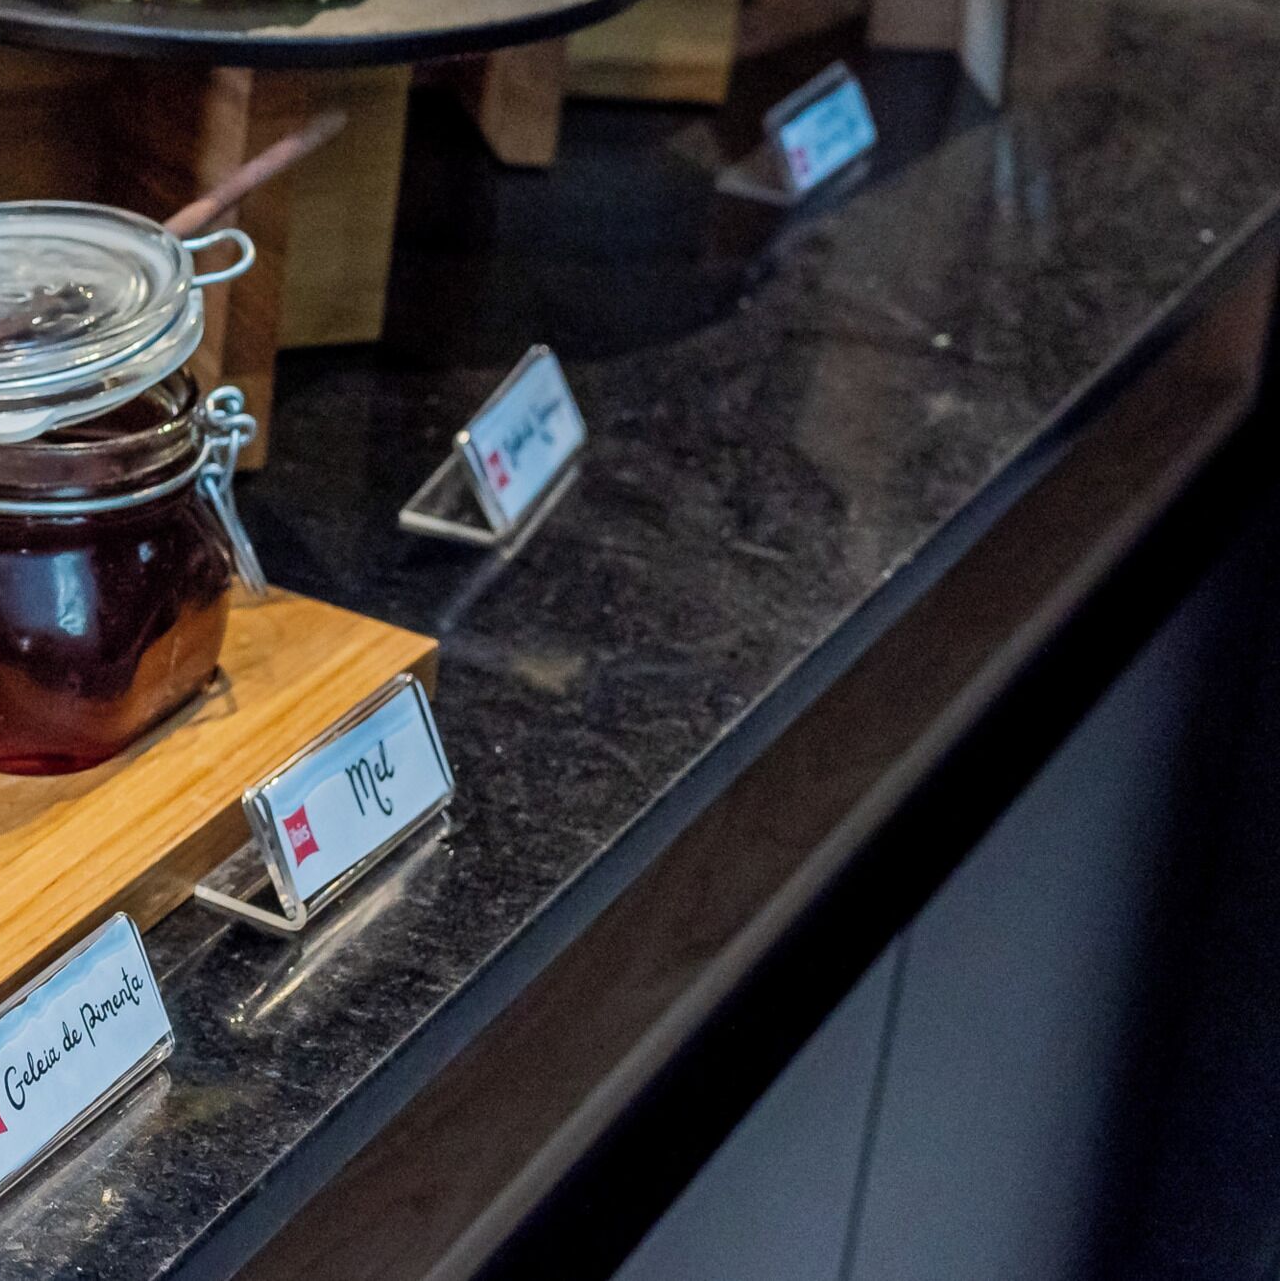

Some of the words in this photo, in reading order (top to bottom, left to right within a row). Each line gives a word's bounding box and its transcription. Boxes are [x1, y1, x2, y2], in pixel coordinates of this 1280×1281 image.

[345, 740, 394, 816] Mel
[4, 1047, 61, 1111] Geleia
[63, 1021, 82, 1052] de
